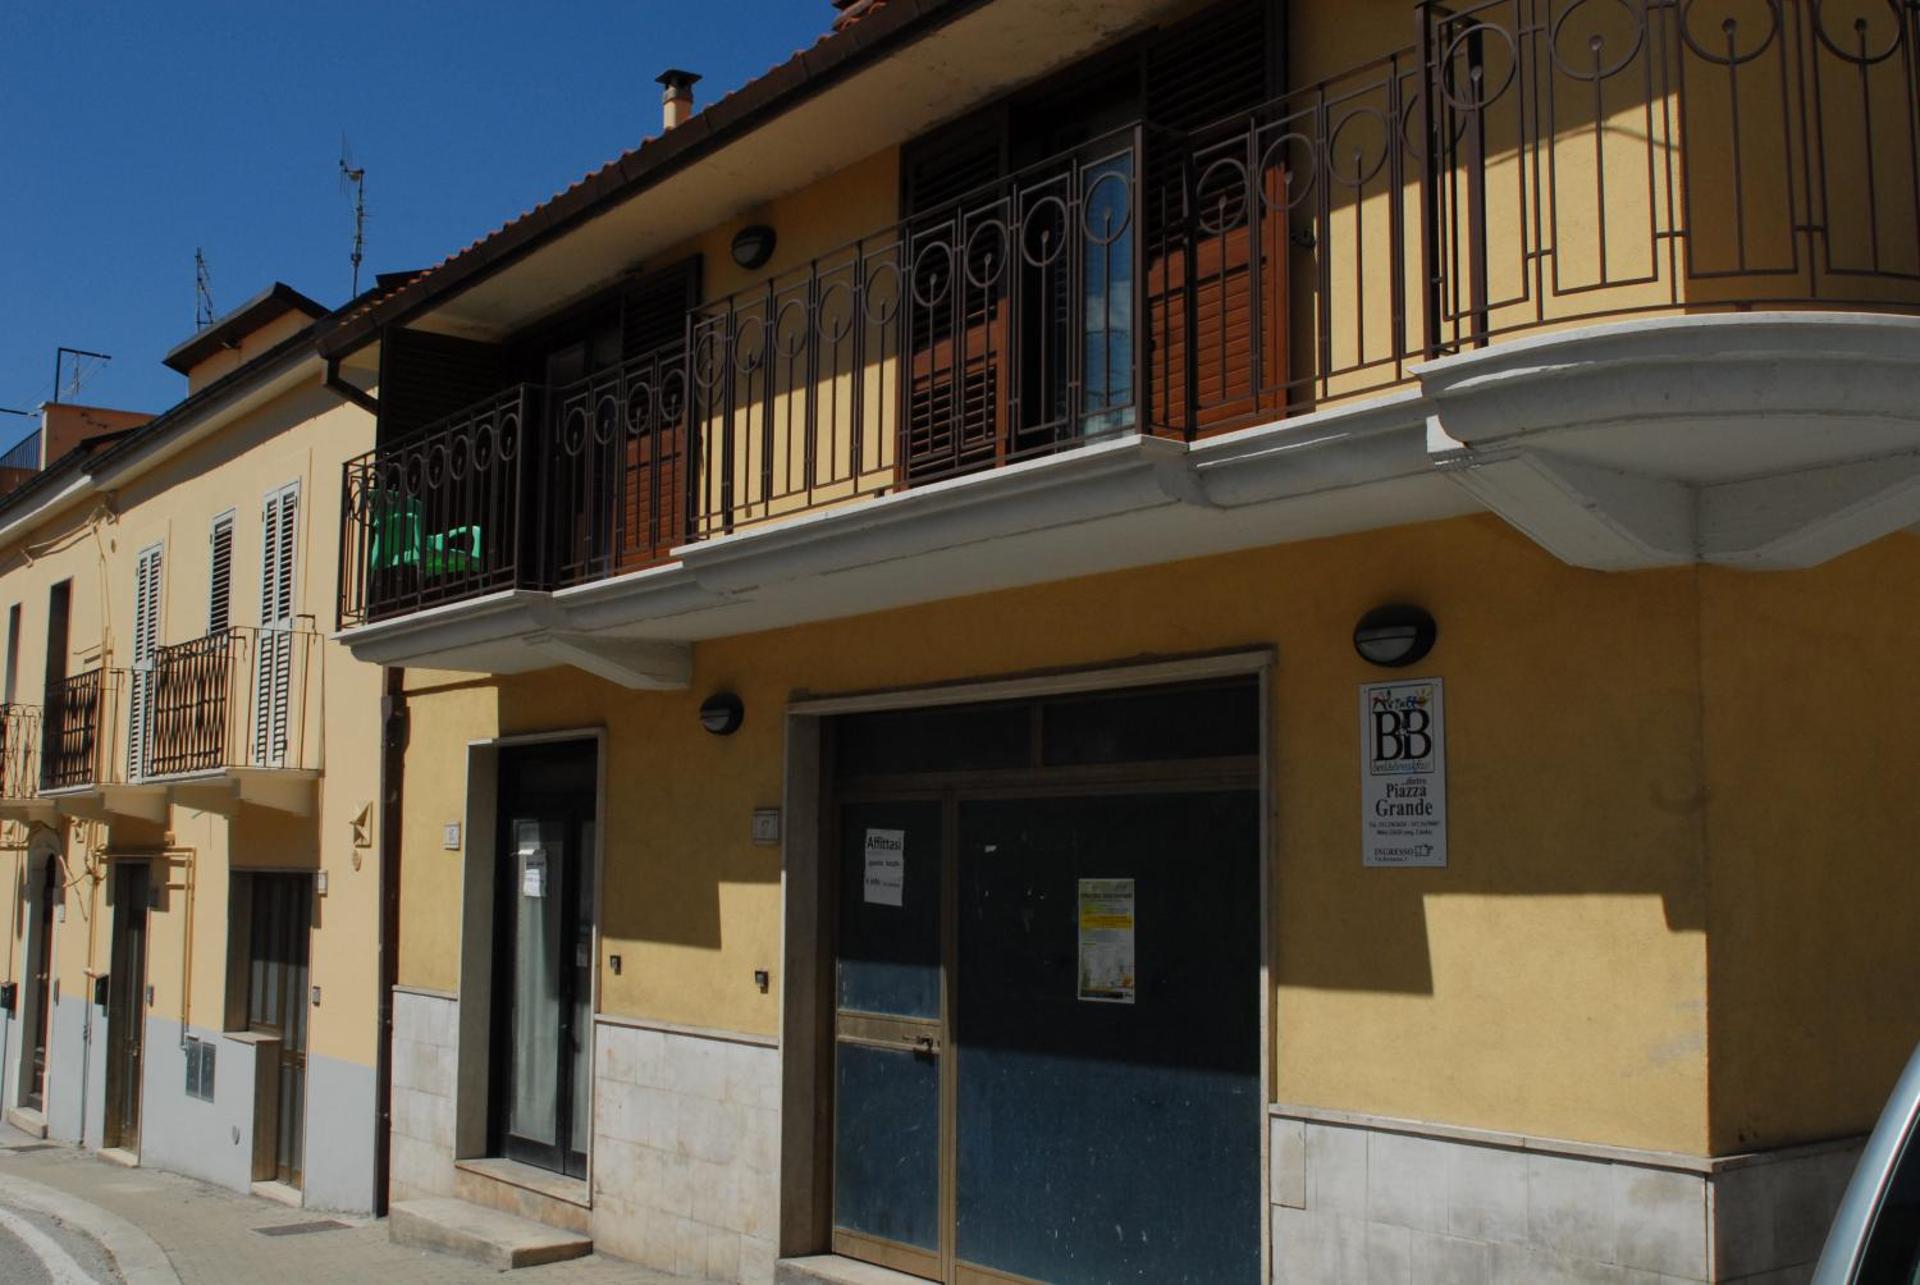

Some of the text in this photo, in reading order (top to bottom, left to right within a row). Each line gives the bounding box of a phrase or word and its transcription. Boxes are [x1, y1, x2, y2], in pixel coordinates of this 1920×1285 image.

[1386, 783, 1427, 798] Piazza
[1375, 798, 1433, 817] Grande
[867, 836, 902, 850] Affittasi
